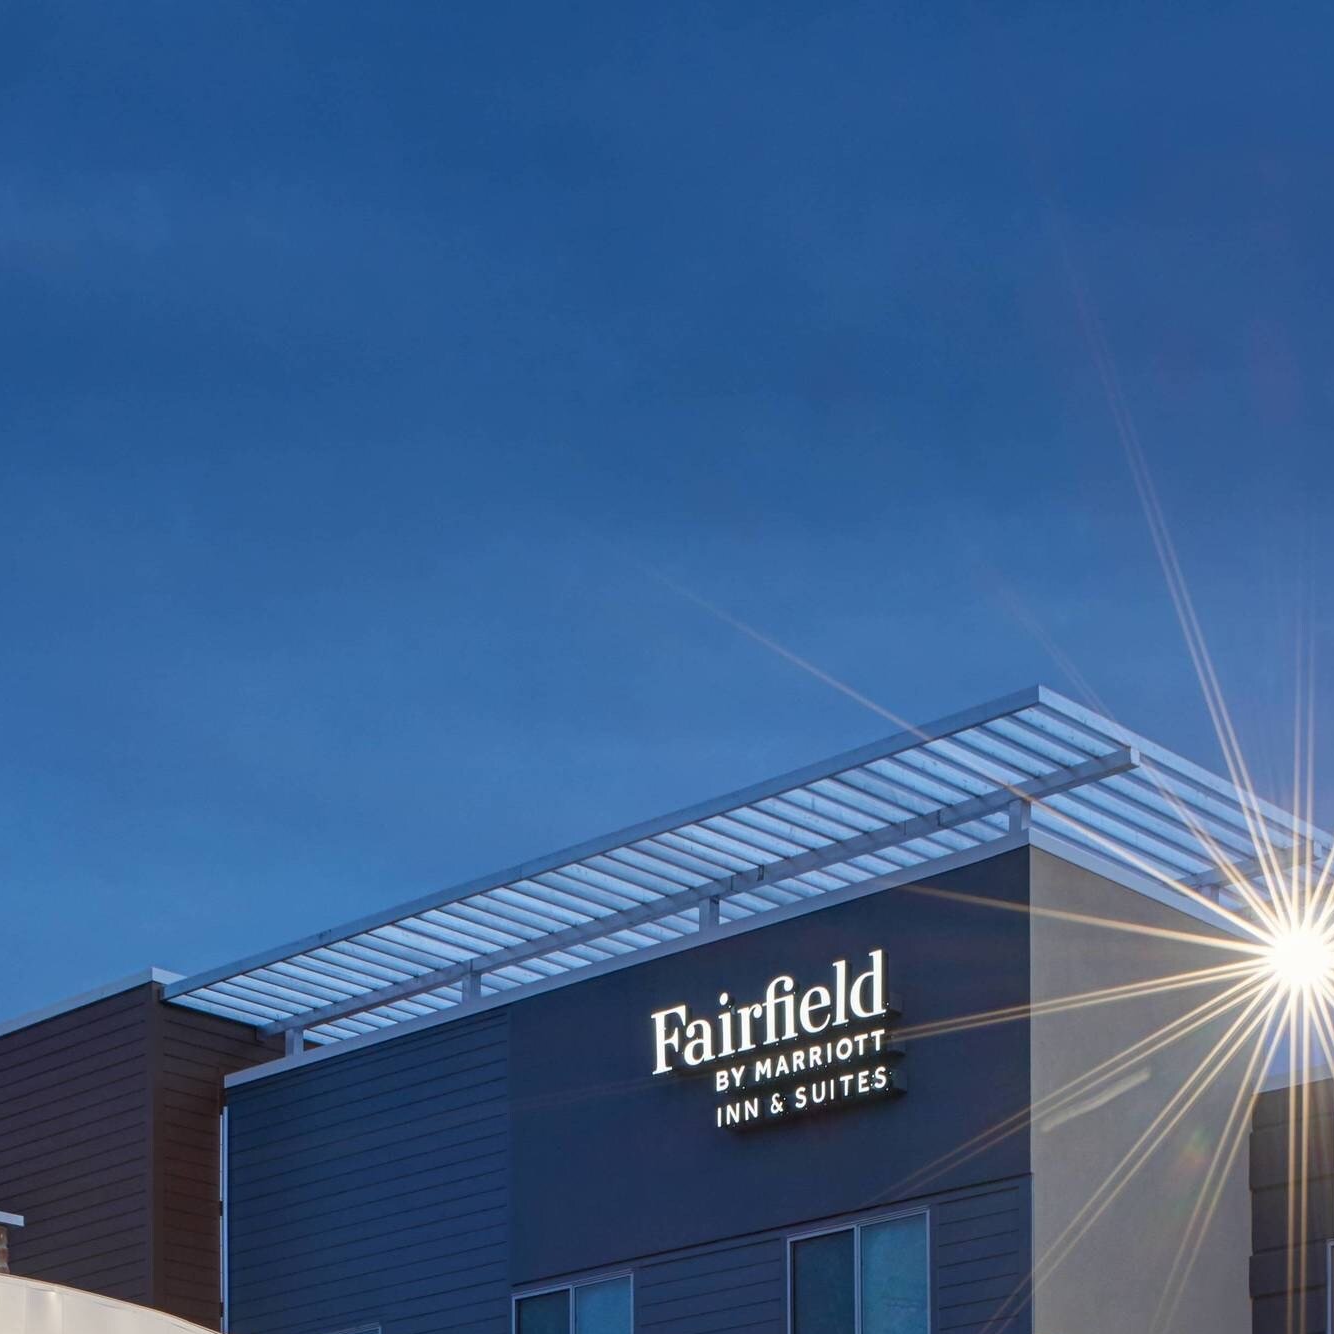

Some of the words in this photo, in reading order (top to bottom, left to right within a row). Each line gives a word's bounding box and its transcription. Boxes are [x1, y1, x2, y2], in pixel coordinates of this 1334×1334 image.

[651, 949, 887, 1076] Fairfield
[715, 1065, 746, 1093] BY
[754, 1029, 887, 1083] MARRIOTT
[716, 1097, 759, 1129] INN
[770, 1092, 786, 1115] &
[794, 1066, 888, 1110] SUITES
